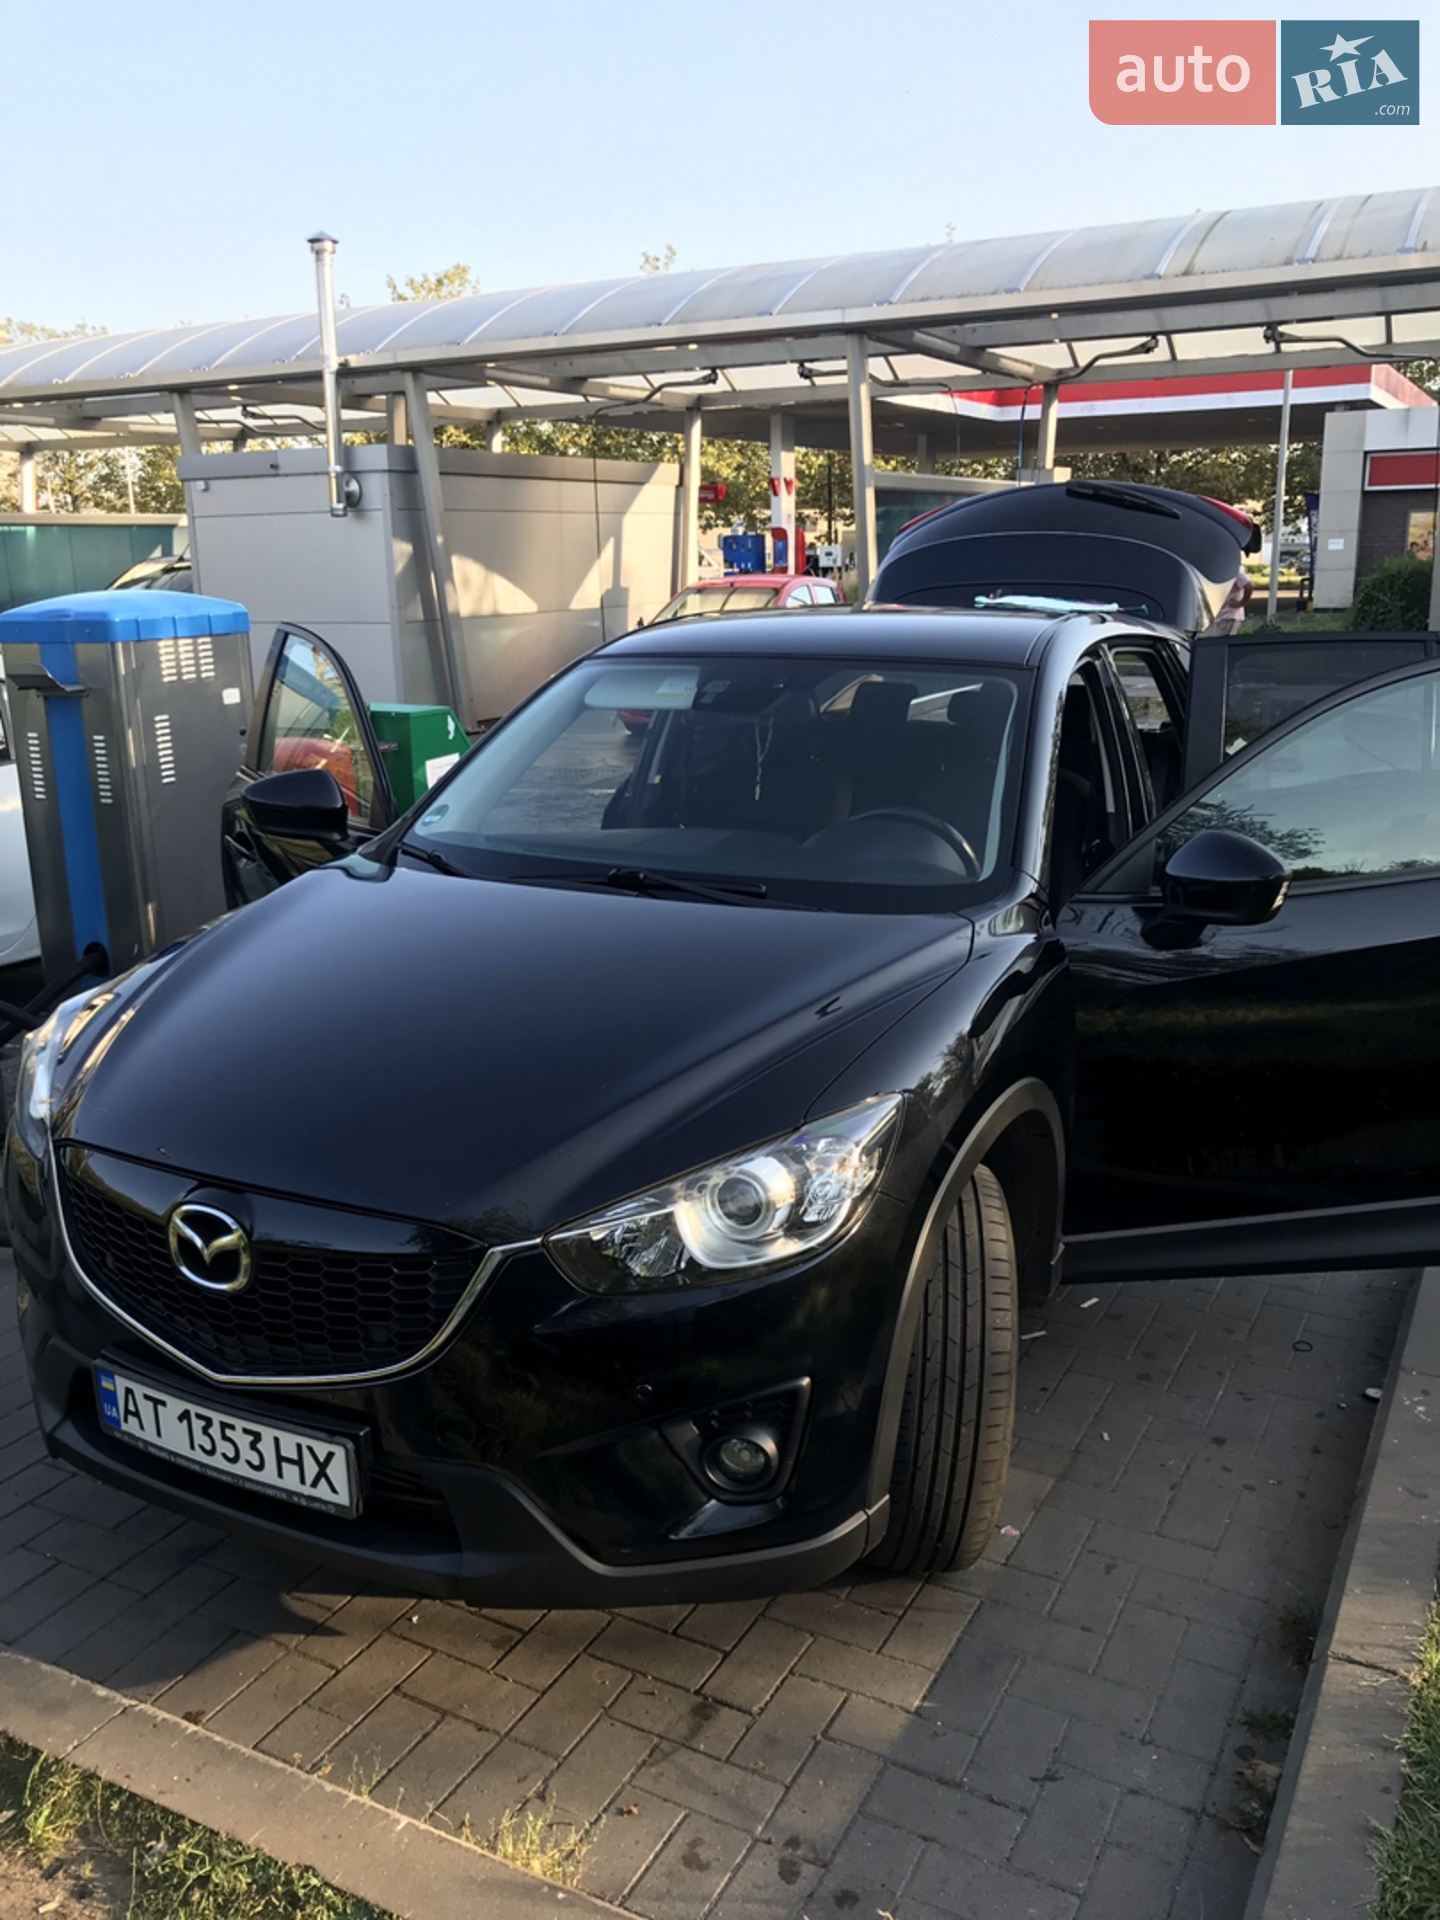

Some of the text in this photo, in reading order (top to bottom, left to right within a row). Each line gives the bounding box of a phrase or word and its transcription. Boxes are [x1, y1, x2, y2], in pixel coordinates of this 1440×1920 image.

[104, 1402, 120, 1419] UA
[123, 1386, 167, 1439] AT
[177, 1408, 265, 1472] 1353
[274, 1436, 339, 1496] HX
